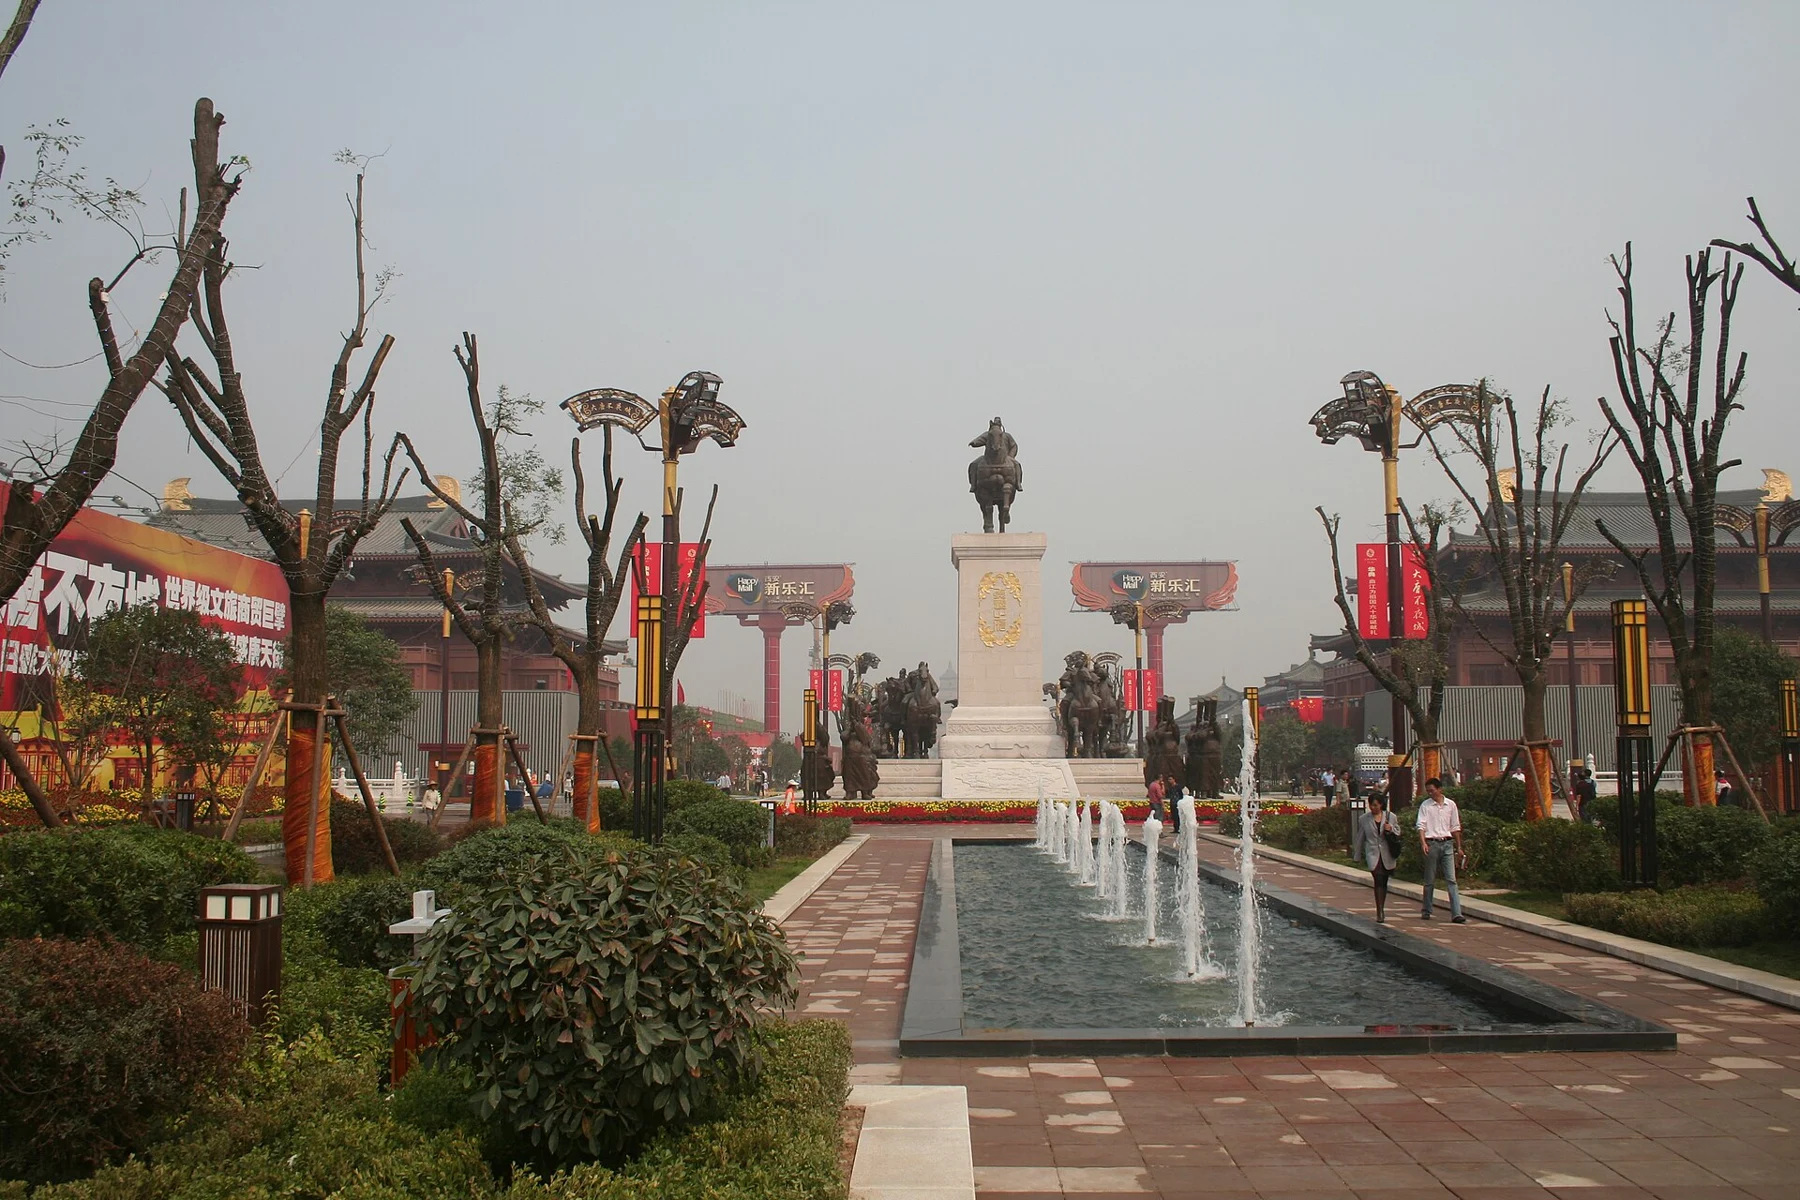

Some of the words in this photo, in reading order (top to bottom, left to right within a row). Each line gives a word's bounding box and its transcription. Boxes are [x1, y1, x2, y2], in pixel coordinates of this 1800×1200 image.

[738, 577, 759, 586] Happy
[1122, 574, 1144, 583] Happy
[738, 584, 753, 592] Mall
[764, 581, 815, 596] 新乐汇
[1122, 581, 1138, 589] Mall
[1150, 578, 1201, 593] 新乐汇
[1412, 569, 1426, 632] 大唐不夜城
